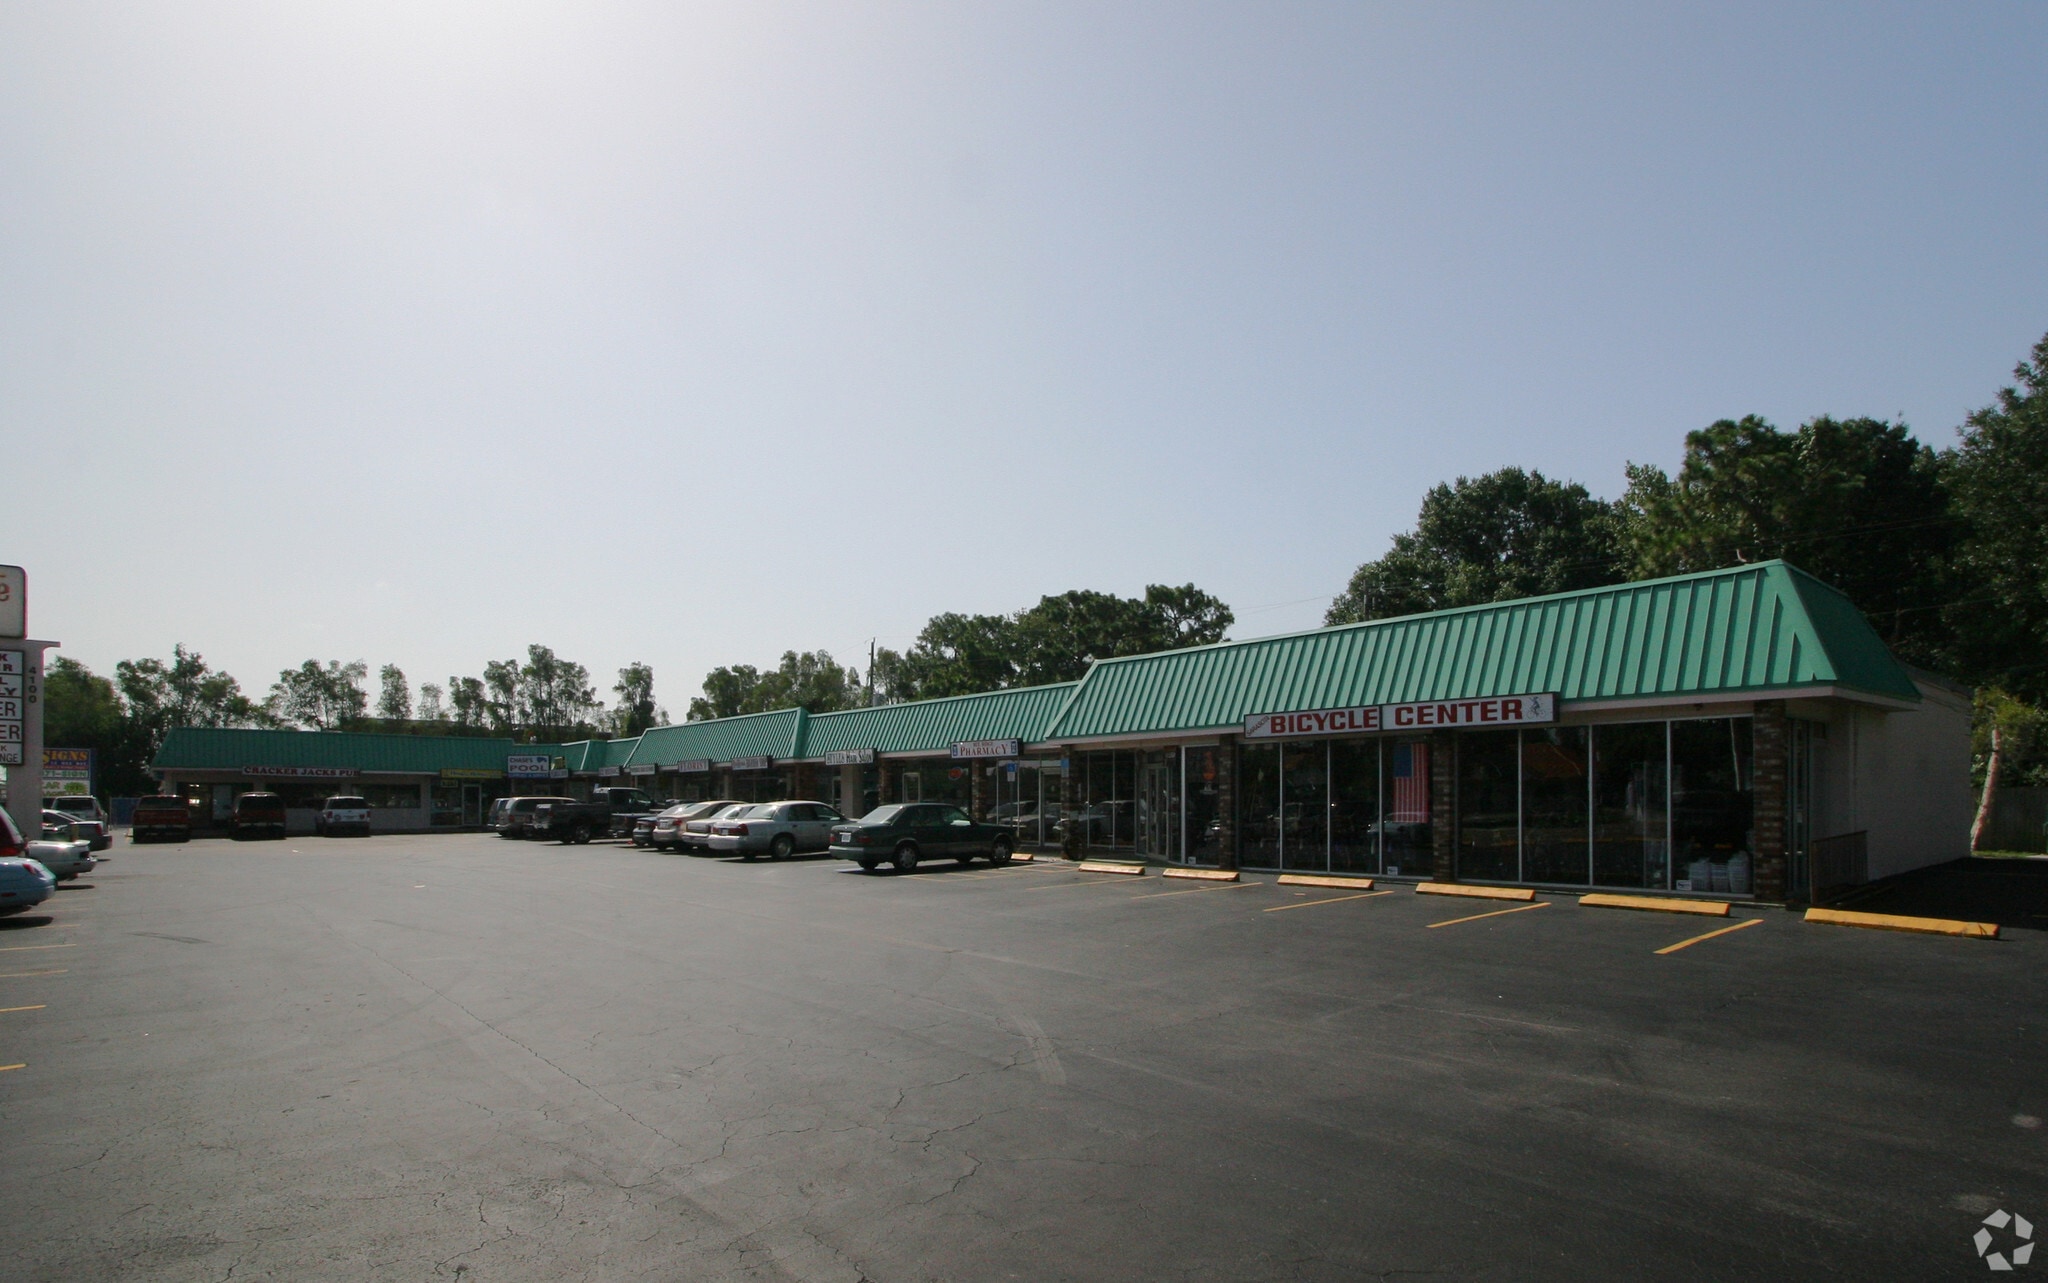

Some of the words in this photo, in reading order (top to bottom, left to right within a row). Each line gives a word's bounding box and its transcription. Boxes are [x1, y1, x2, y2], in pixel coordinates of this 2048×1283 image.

[1270, 708, 1378, 734] BICYCLE
[1394, 699, 1523, 726] CENTER
[960, 744, 1007, 756] PHARMACY
[42, 750, 88, 763] SIGNS
[244, 767, 298, 775] CRACKER
[301, 768, 336, 776] JACKS
[339, 769, 361, 777] PUB
